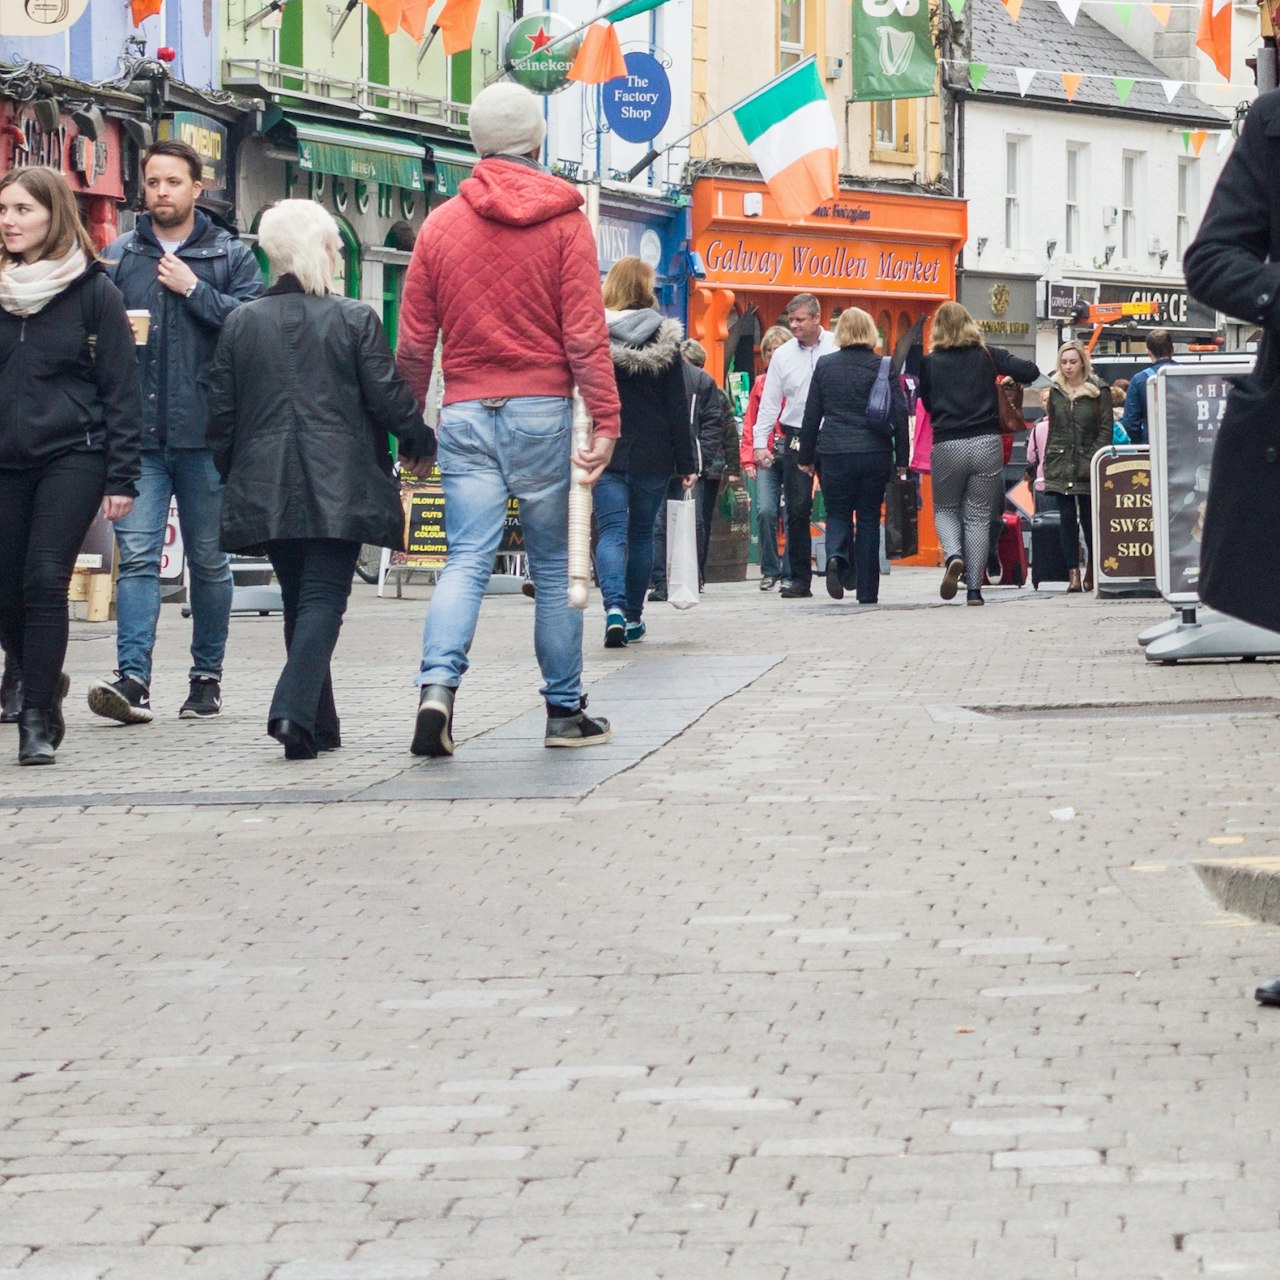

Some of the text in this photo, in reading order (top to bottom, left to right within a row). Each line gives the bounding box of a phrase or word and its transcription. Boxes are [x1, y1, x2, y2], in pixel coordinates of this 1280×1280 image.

[625, 74, 649, 88] The
[613, 89, 659, 107] Factory
[620, 105, 652, 122] Shop
[705, 238, 941, 284] Galway Woollen Market
[1196, 383, 1228, 398] CHI
[1114, 493, 1153, 509] IRIS
[421, 511, 443, 519] CUTS
[421, 525, 441, 533] HAIR
[1109, 518, 1155, 533] SWE
[414, 531, 447, 539] COLOUR
[1117, 543, 1153, 558] SHO
